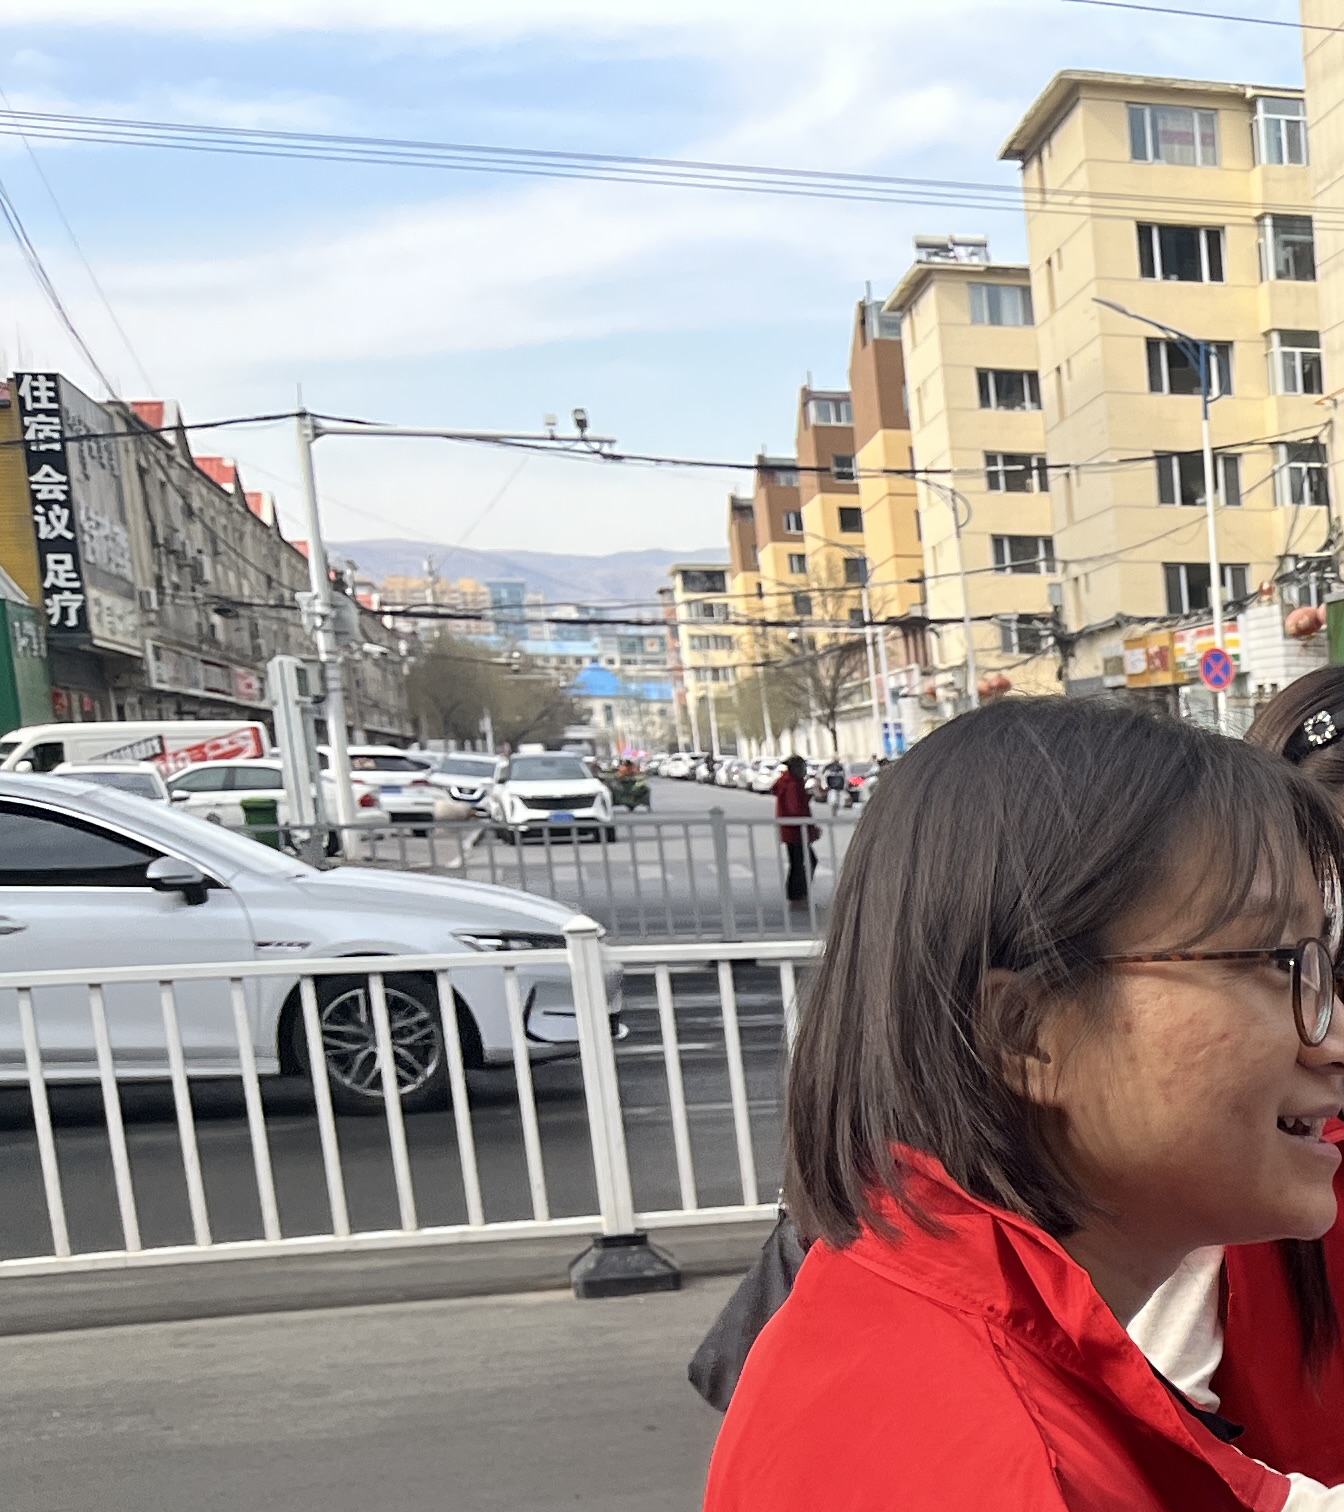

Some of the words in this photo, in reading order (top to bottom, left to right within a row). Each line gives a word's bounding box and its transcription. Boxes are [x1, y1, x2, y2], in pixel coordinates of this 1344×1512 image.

[18, 374, 62, 451] 住宿
[29, 464, 75, 540] 会议
[43, 552, 84, 628] 足疗
